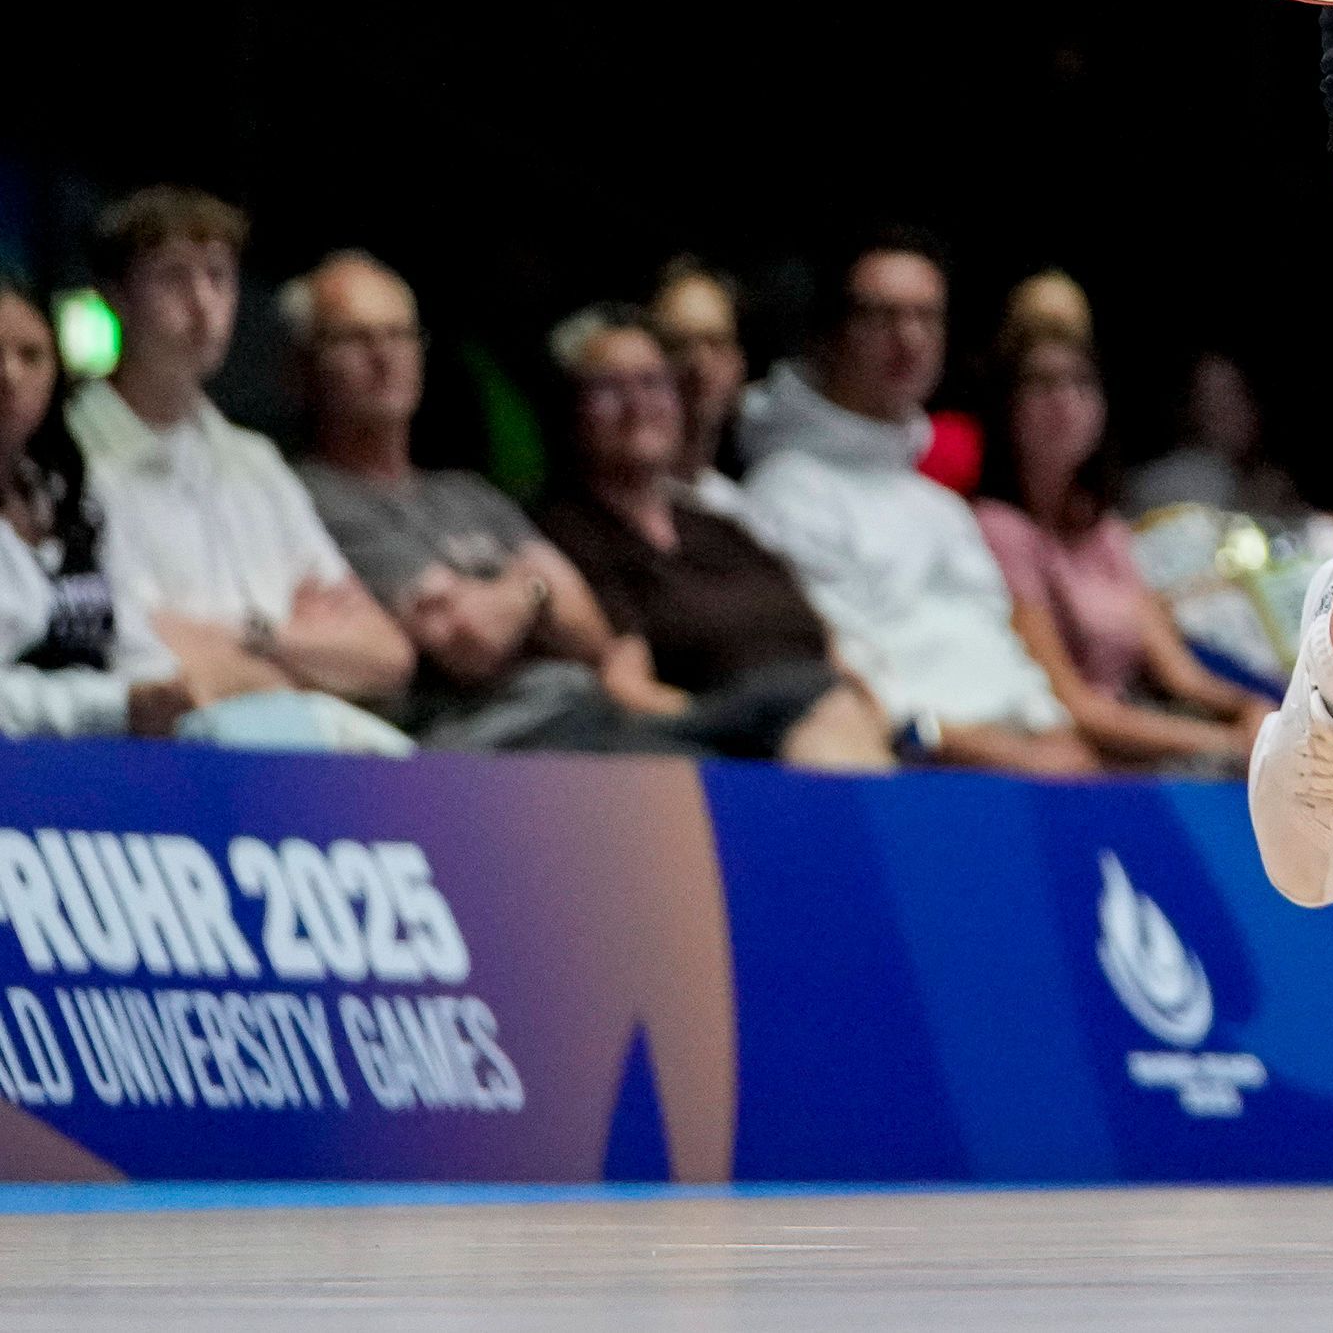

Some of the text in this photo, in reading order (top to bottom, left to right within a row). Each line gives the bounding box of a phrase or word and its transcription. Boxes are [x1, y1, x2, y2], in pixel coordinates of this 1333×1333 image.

[0, 828, 471, 985] RUHR 2025
[55, 986, 351, 1110] UNIVERSITY
[338, 993, 525, 1112] GAMES
